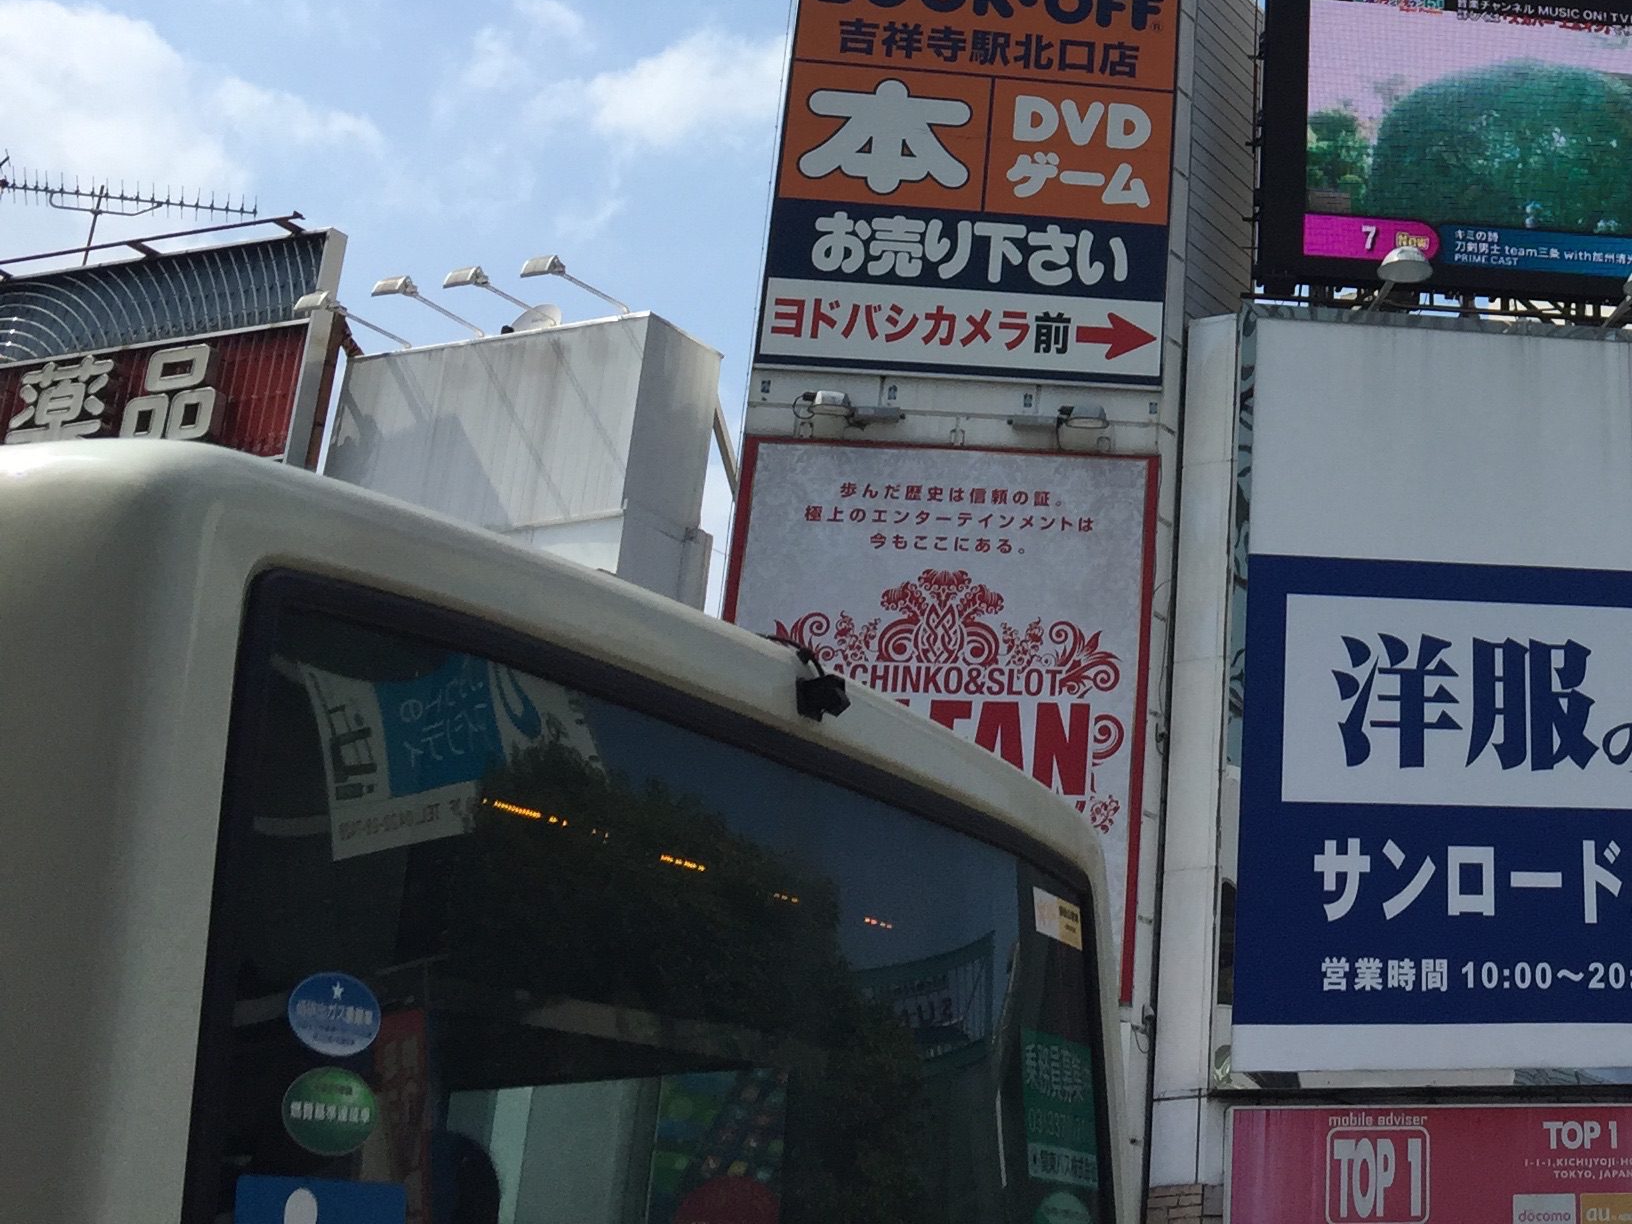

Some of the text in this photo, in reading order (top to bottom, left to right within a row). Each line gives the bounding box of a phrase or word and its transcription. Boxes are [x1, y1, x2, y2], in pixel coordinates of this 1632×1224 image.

[1538, 6, 1580, 19] MUSIC
[839, 18, 1141, 78] 吉祥寺駅北口店
[1012, 94, 1152, 150] DVD
[797, 78, 973, 196] 本
[1006, 151, 1151, 209] ゲーム
[811, 210, 1129, 287] お売り下さい
[1361, 225, 1376, 250] 7
[1454, 229, 1499, 243] キミの詩
[1454, 253, 1520, 267] PRIME CAST
[770, 296, 1072, 355] ヨドバシカメラ前
[3, 343, 214, 444] 薬品
[840, 482, 1064, 507] 歩んだ歴史は信頼の証。
[804, 505, 1095, 533] 極上のエンターテインメントは
[869, 533, 1026, 555] 今もここにある。
[1321, 957, 1449, 992] 営業時間
[1328, 1112, 1428, 1127] mobile adviser
[1543, 1121, 1601, 1150] TOP
[1608, 1121, 1618, 1150] 1
[1333, 1137, 1422, 1219] TOP 1
[1518, 1209, 1571, 1223] docomo
[1586, 1207, 1611, 1223] au
